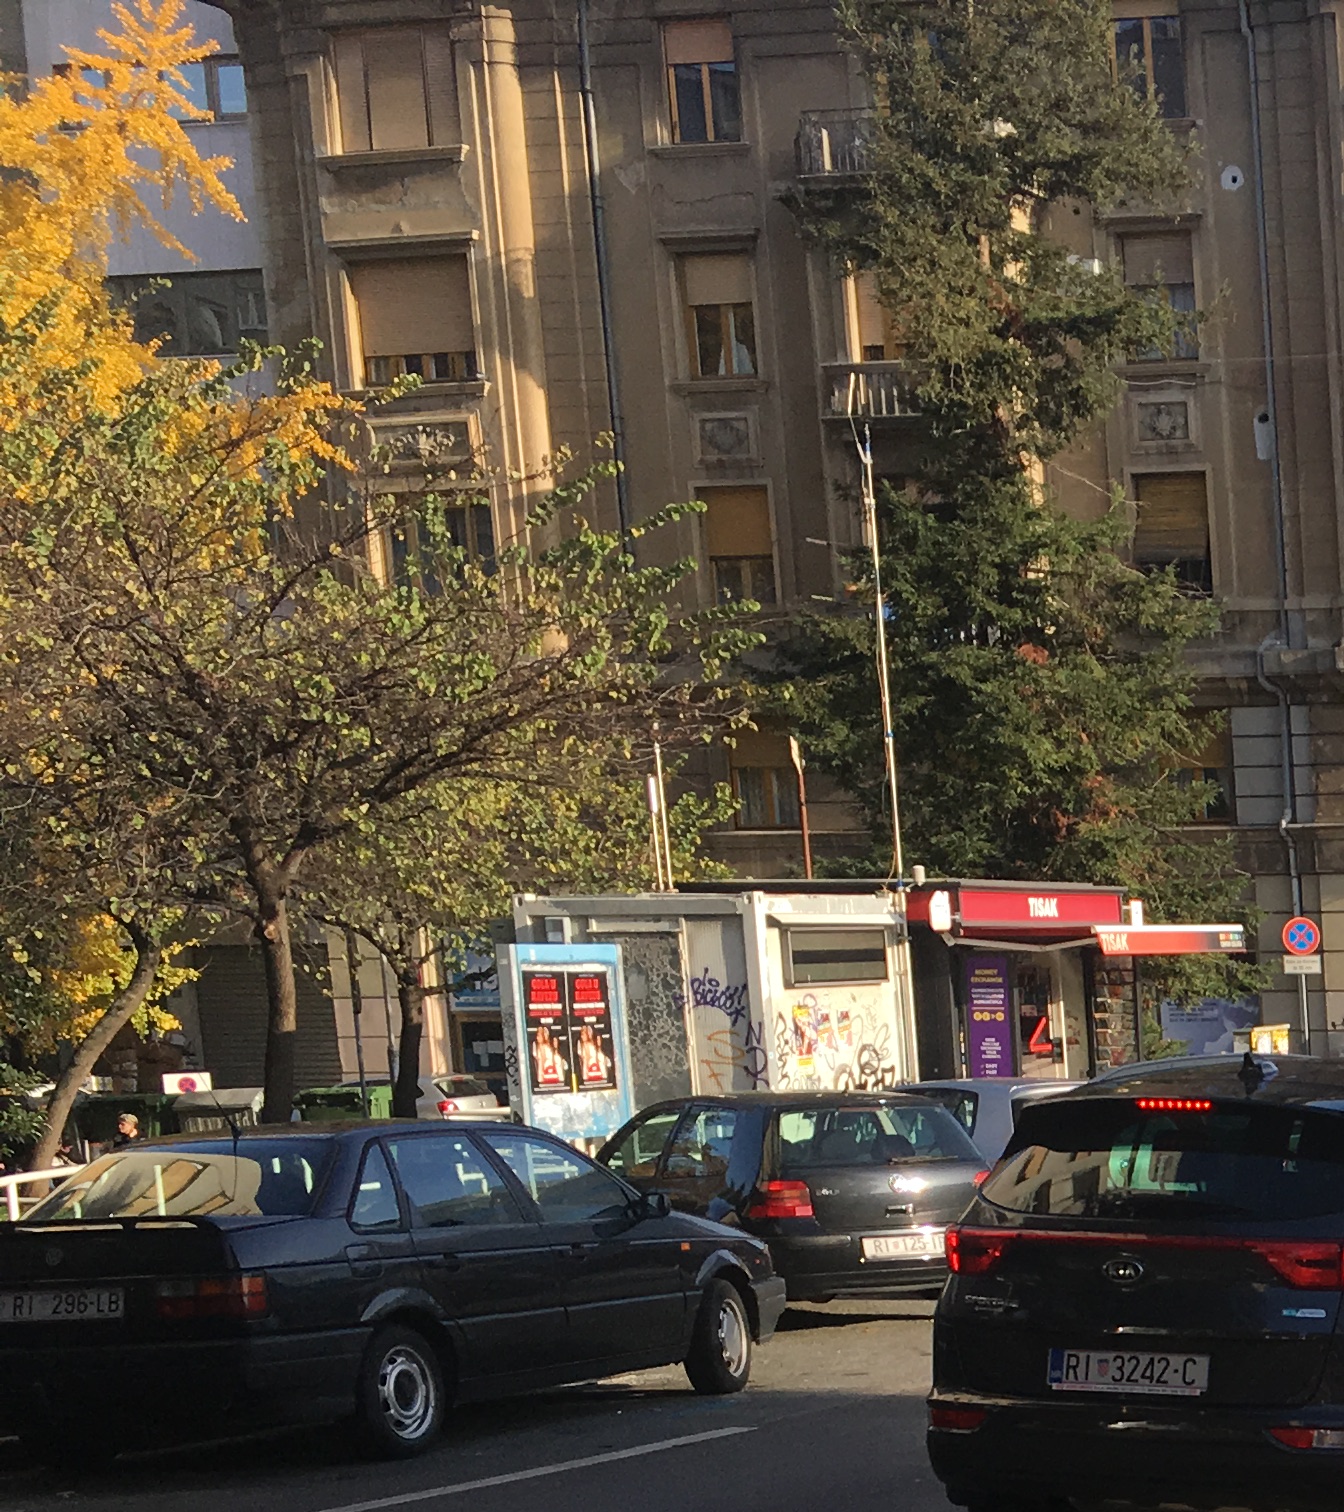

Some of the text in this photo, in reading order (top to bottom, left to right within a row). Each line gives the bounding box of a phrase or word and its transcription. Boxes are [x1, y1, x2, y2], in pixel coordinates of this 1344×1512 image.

[1028, 898, 1058, 917] TISAK
[1101, 933, 1129, 952] TISAK
[873, 1240, 889, 1253] RI
[13, 1292, 119, 1316] RI 296-LB
[1065, 1354, 1090, 1381] RI
[1111, 1355, 1197, 1386] 3242-C
